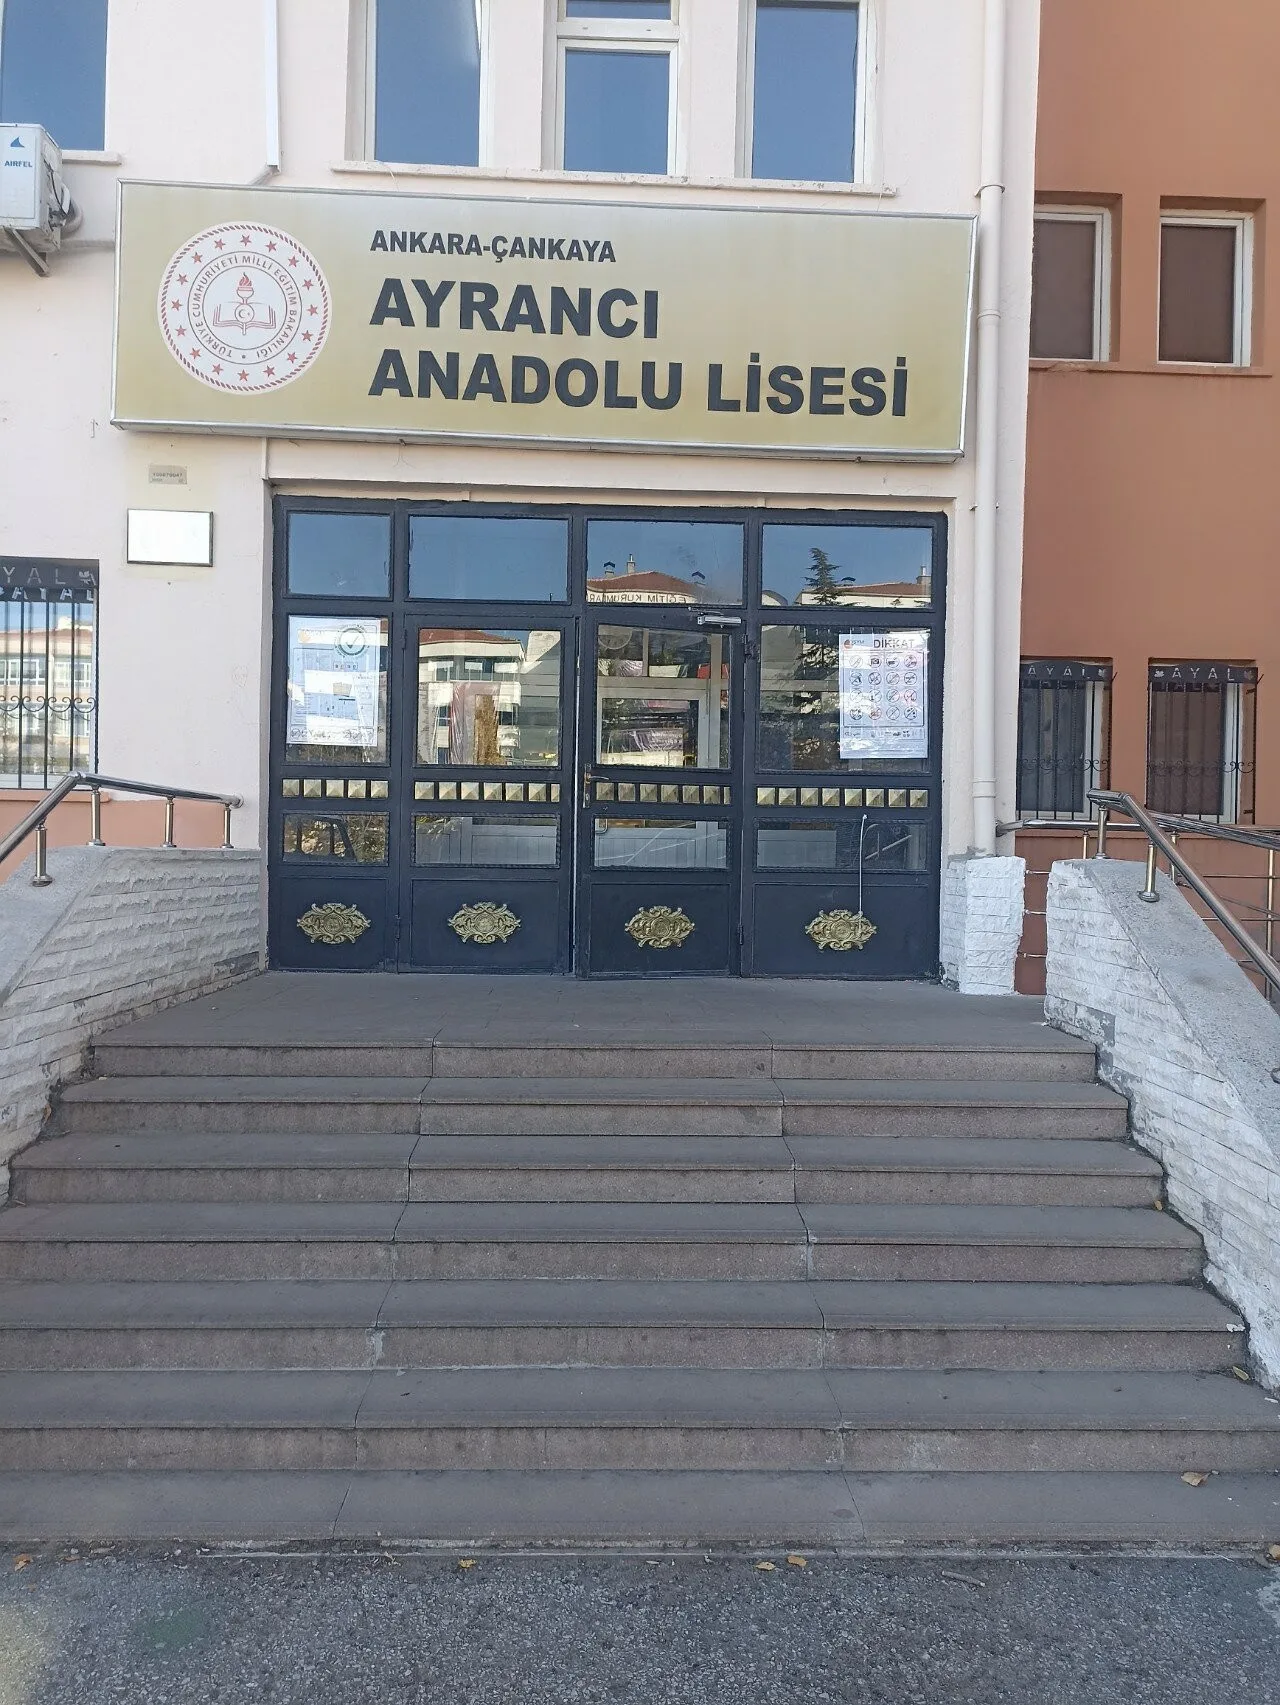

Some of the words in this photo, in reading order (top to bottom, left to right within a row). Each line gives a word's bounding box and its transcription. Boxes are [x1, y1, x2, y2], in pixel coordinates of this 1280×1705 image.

[4, 160, 33, 168] AIRFEL
[371, 230, 616, 262] ANKARA-ÇANKAYA
[192, 254, 238, 318] CUMHURİYETİ
[274, 269, 298, 306] EĞİTİM
[370, 278, 658, 338] AYRANCI
[195, 321, 233, 358] TÜRKİYE
[256, 309, 298, 359] BAKANLIĞI
[368, 349, 682, 410] ANADOLU
[708, 353, 907, 416] LİSESİ
[873, 637, 915, 649] DİKKAT
[1028, 665, 1090, 679] AYAL
[1172, 667, 1235, 681] AYAL
